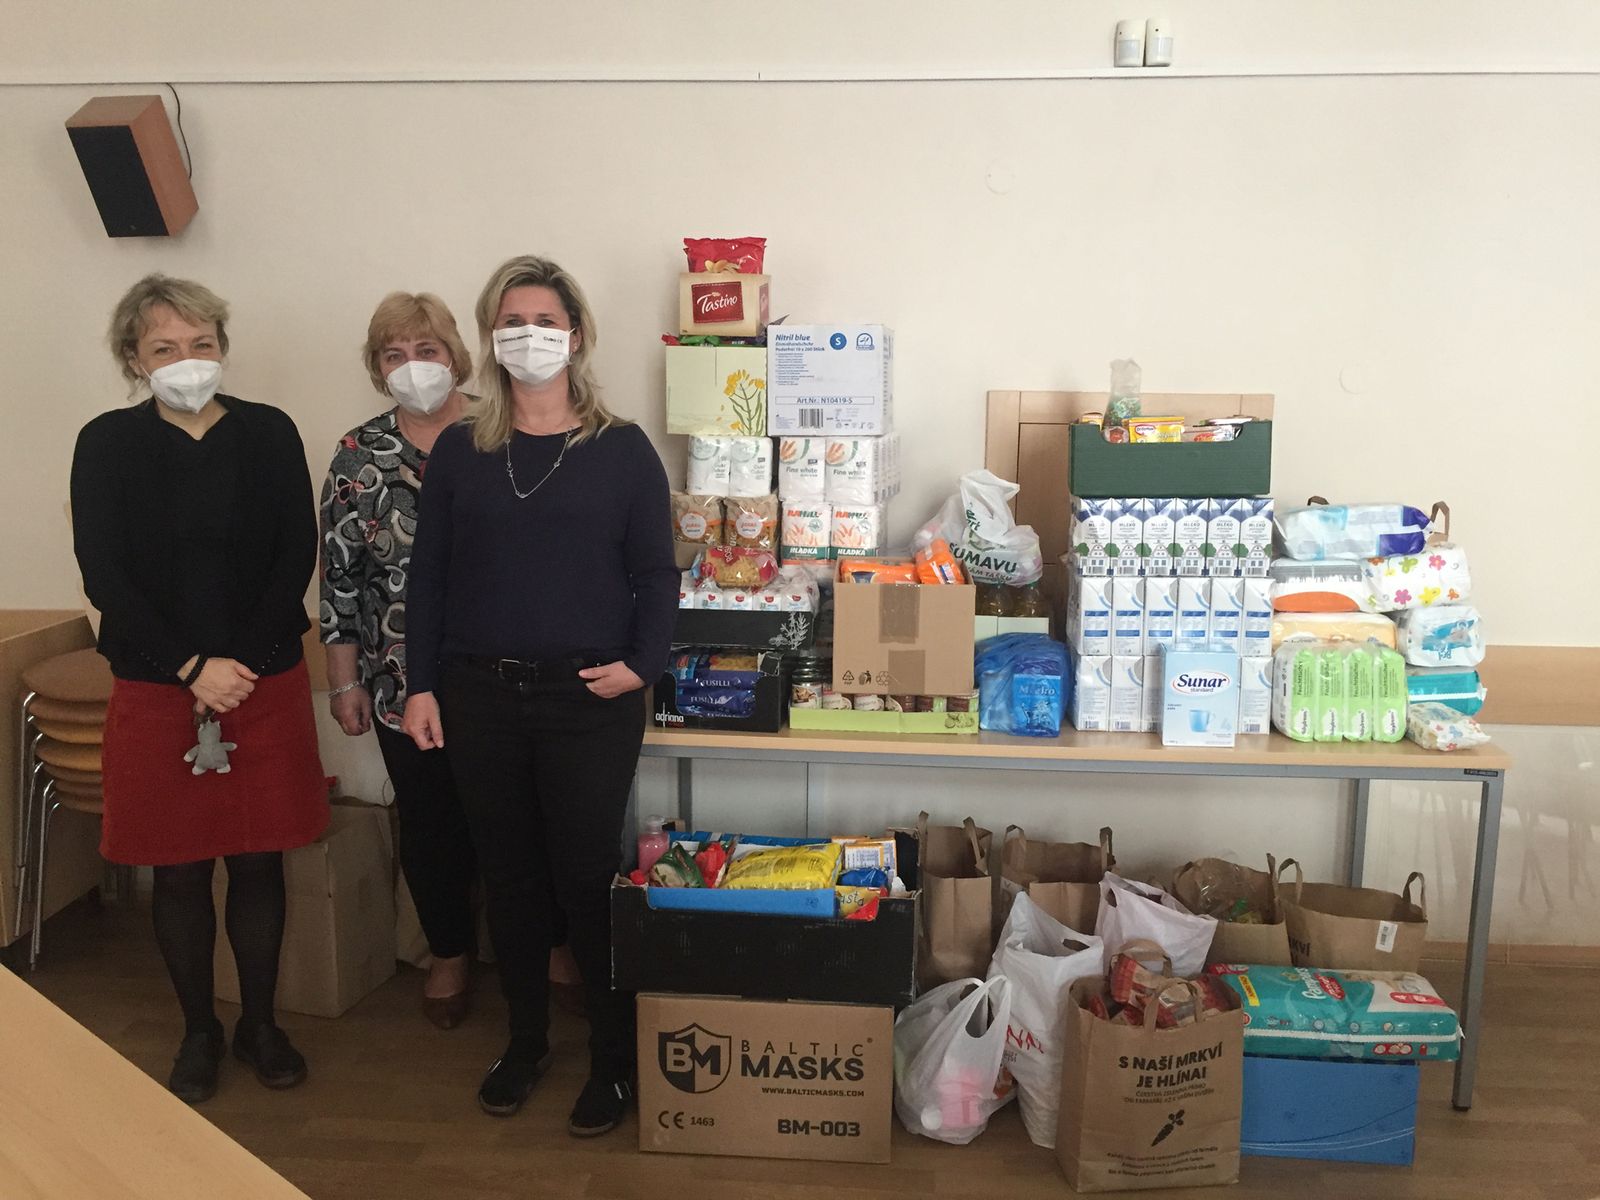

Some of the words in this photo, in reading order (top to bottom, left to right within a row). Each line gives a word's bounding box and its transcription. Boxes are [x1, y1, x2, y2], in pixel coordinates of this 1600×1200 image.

[696, 294, 738, 314] Tastino
[835, 337, 841, 346] S
[1177, 674, 1227, 688] Sunar
[655, 702, 684, 728] adriana
[741, 1039, 864, 1057] BALTIC
[1118, 1056, 1129, 1069] S
[1132, 1055, 1174, 1071] NAŠÍ
[1176, 1041, 1223, 1069] MRKVÍ
[740, 1054, 864, 1081] MASKS
[1136, 1075, 1154, 1088] JE
[761, 1087, 865, 1097] WWW.BALTICMASKS.COM
[690, 1116, 715, 1127] 1463
[777, 1118, 861, 1137] BM-003
